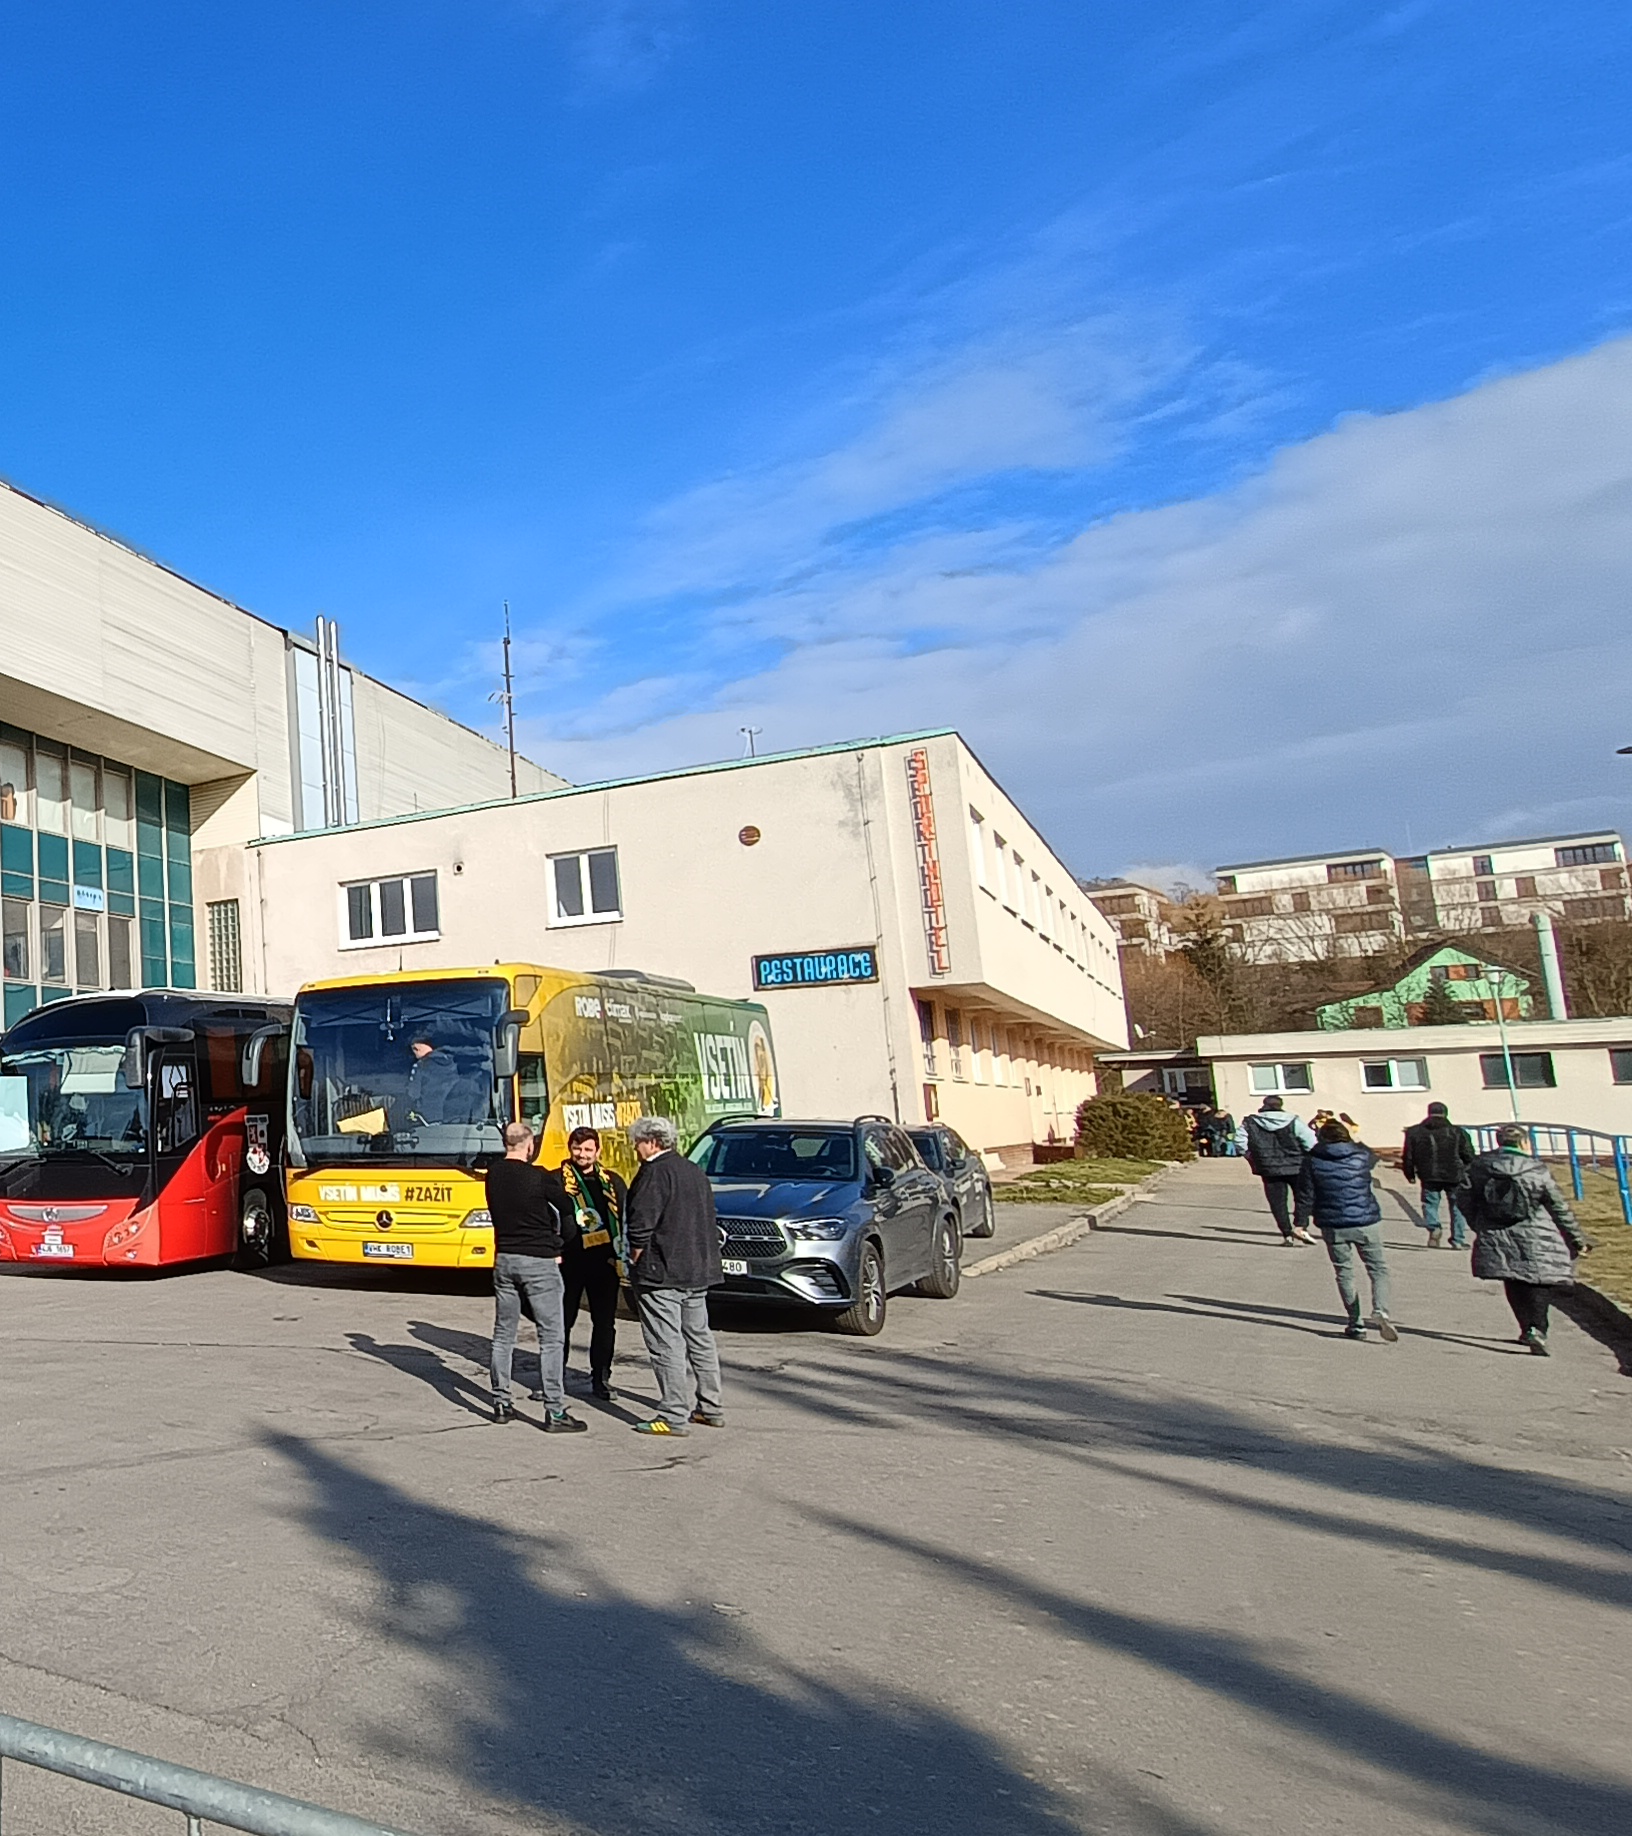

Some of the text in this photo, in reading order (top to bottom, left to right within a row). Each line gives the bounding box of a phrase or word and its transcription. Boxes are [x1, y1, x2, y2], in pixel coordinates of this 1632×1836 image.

[693, 1020, 753, 1100] VSETÍN
[318, 1182, 358, 1202] VSETÍN
[405, 1183, 453, 1202] #ZAŽÍT
